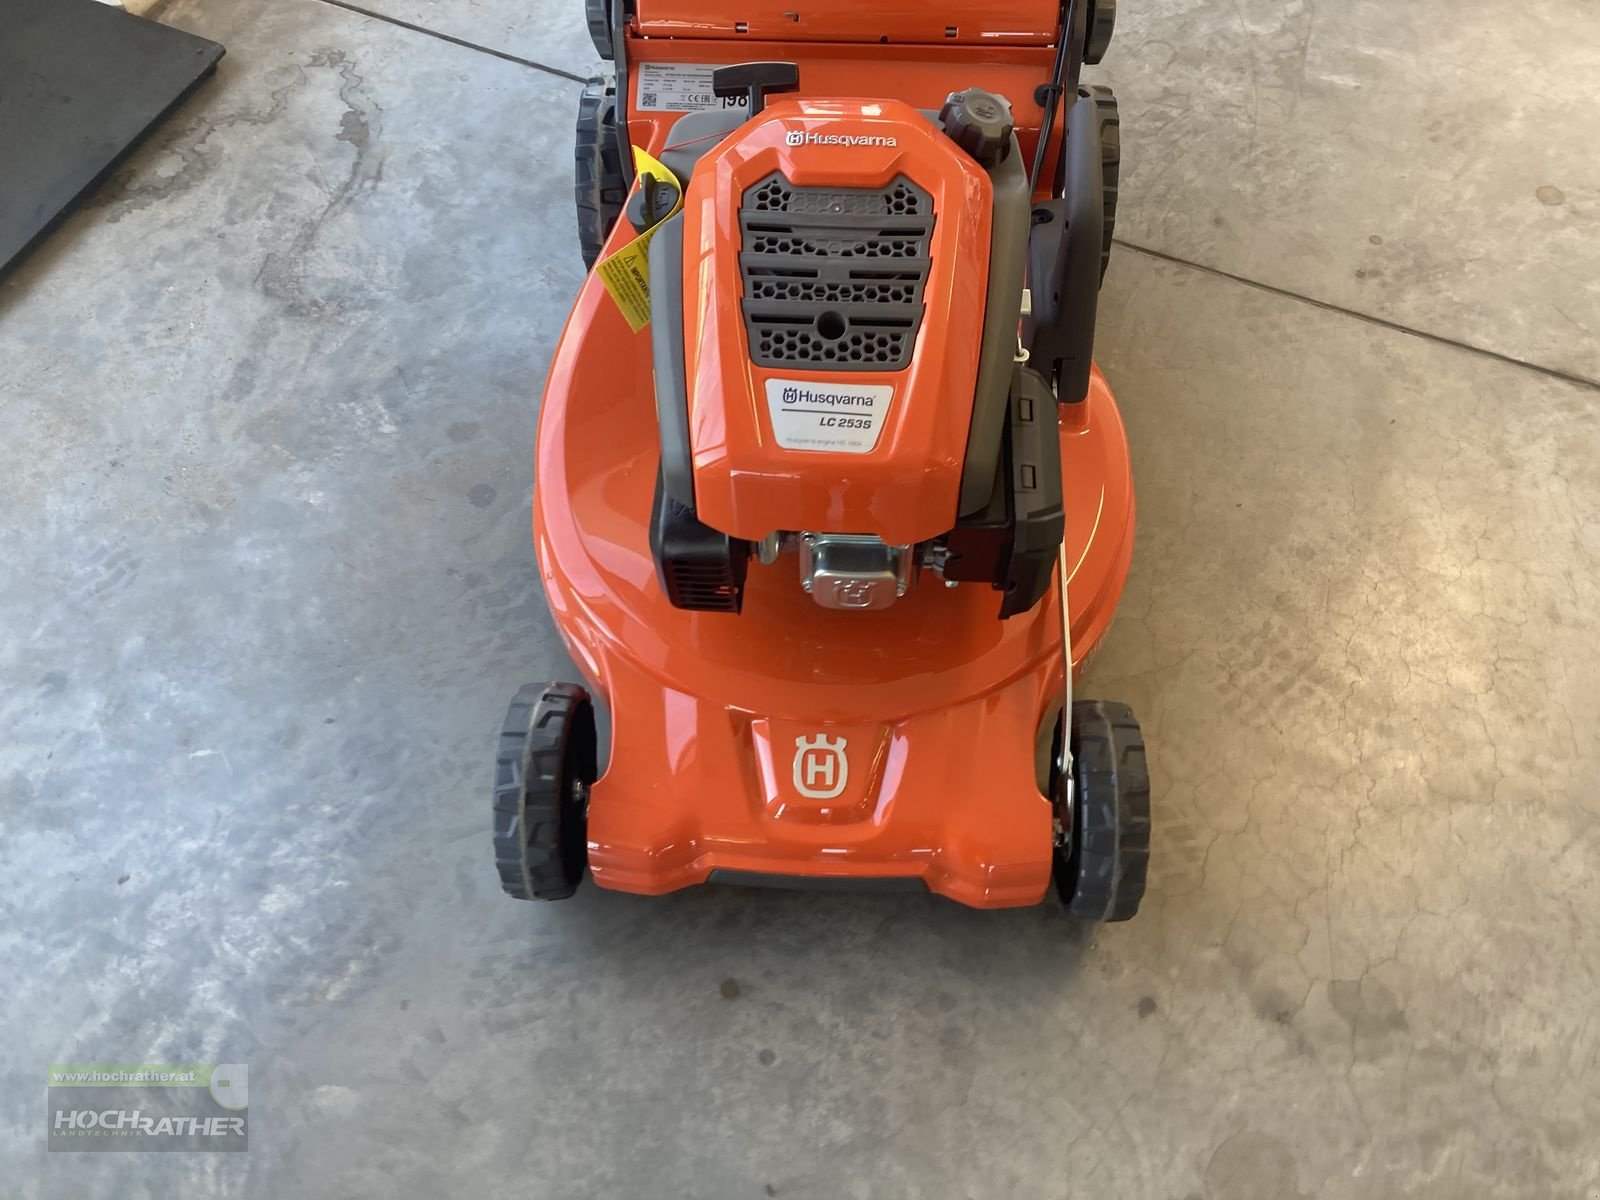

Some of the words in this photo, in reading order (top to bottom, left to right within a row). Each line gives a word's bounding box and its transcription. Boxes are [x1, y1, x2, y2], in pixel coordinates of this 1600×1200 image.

[805, 132, 897, 147] Husqvarna
[799, 391, 873, 406] Husqvarna
[819, 417, 836, 427] LC
[838, 418, 872, 429] 253S
